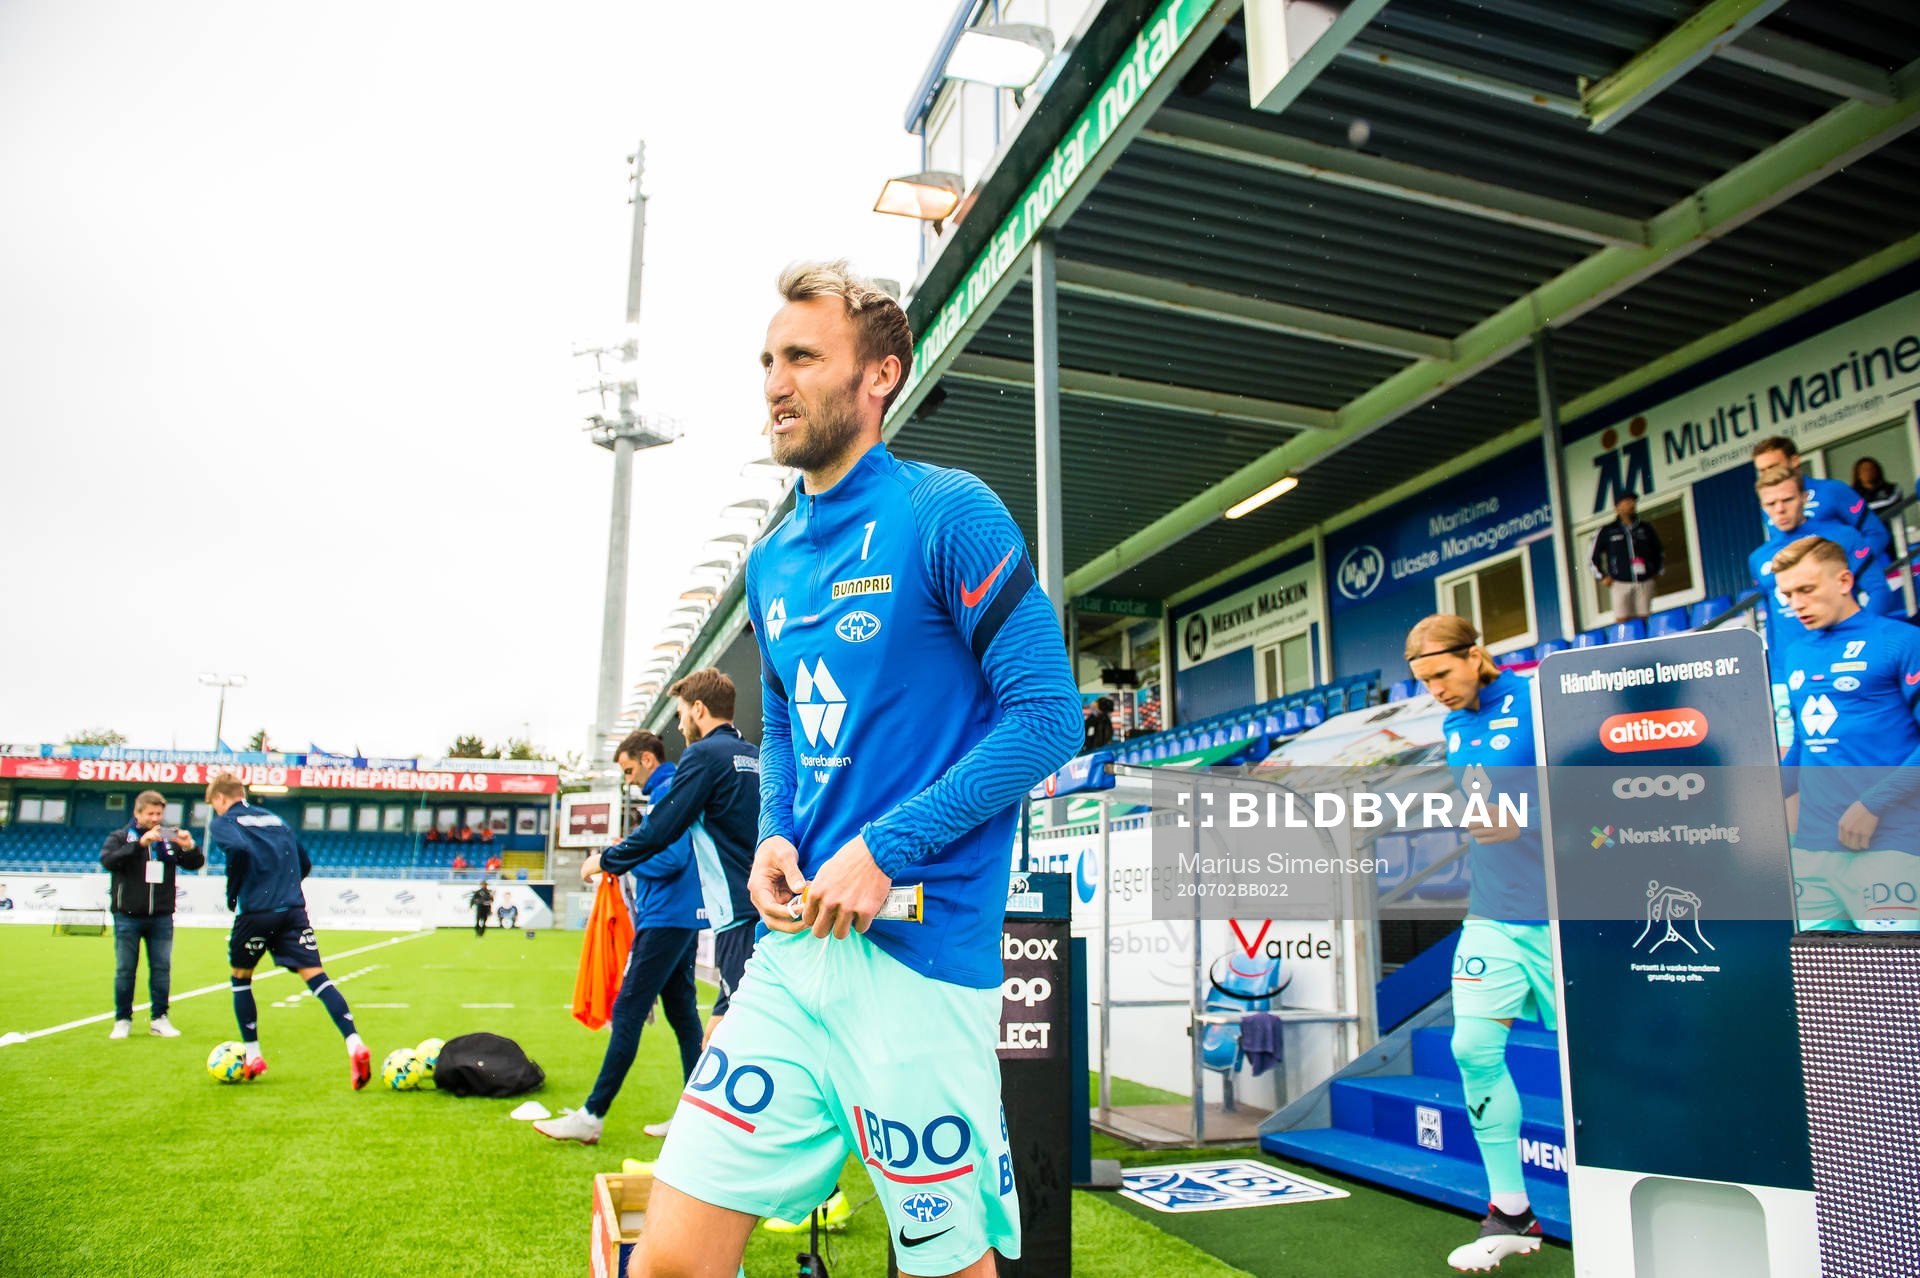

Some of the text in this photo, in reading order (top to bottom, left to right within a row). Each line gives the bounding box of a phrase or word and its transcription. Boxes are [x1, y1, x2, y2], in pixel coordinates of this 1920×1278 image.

[1098, 0, 1183, 143] notar
[1024, 120, 1089, 238] notar
[968, 216, 1018, 314] notar
[1664, 335, 1920, 464] Multi Marine
[1429, 497, 1499, 536] Maritime
[861, 520, 876, 560] 1
[1391, 505, 1553, 580] Waste Management
[1560, 656, 1740, 694] Håndhygiene leveres av:
[1609, 718, 1698, 744] altibox
[78, 760, 178, 782] STRAND
[182, 766, 200, 783] &
[459, 775, 488, 791] AS
[1612, 773, 1705, 800] coop
[1619, 824, 1740, 845] Norsk Tipping
[1229, 918, 1331, 960] Varde
[1002, 977, 1051, 1007] op
[690, 1045, 774, 1114] DO
[864, 1109, 971, 1169] BDO
[1518, 1137, 1568, 1173] MEN
